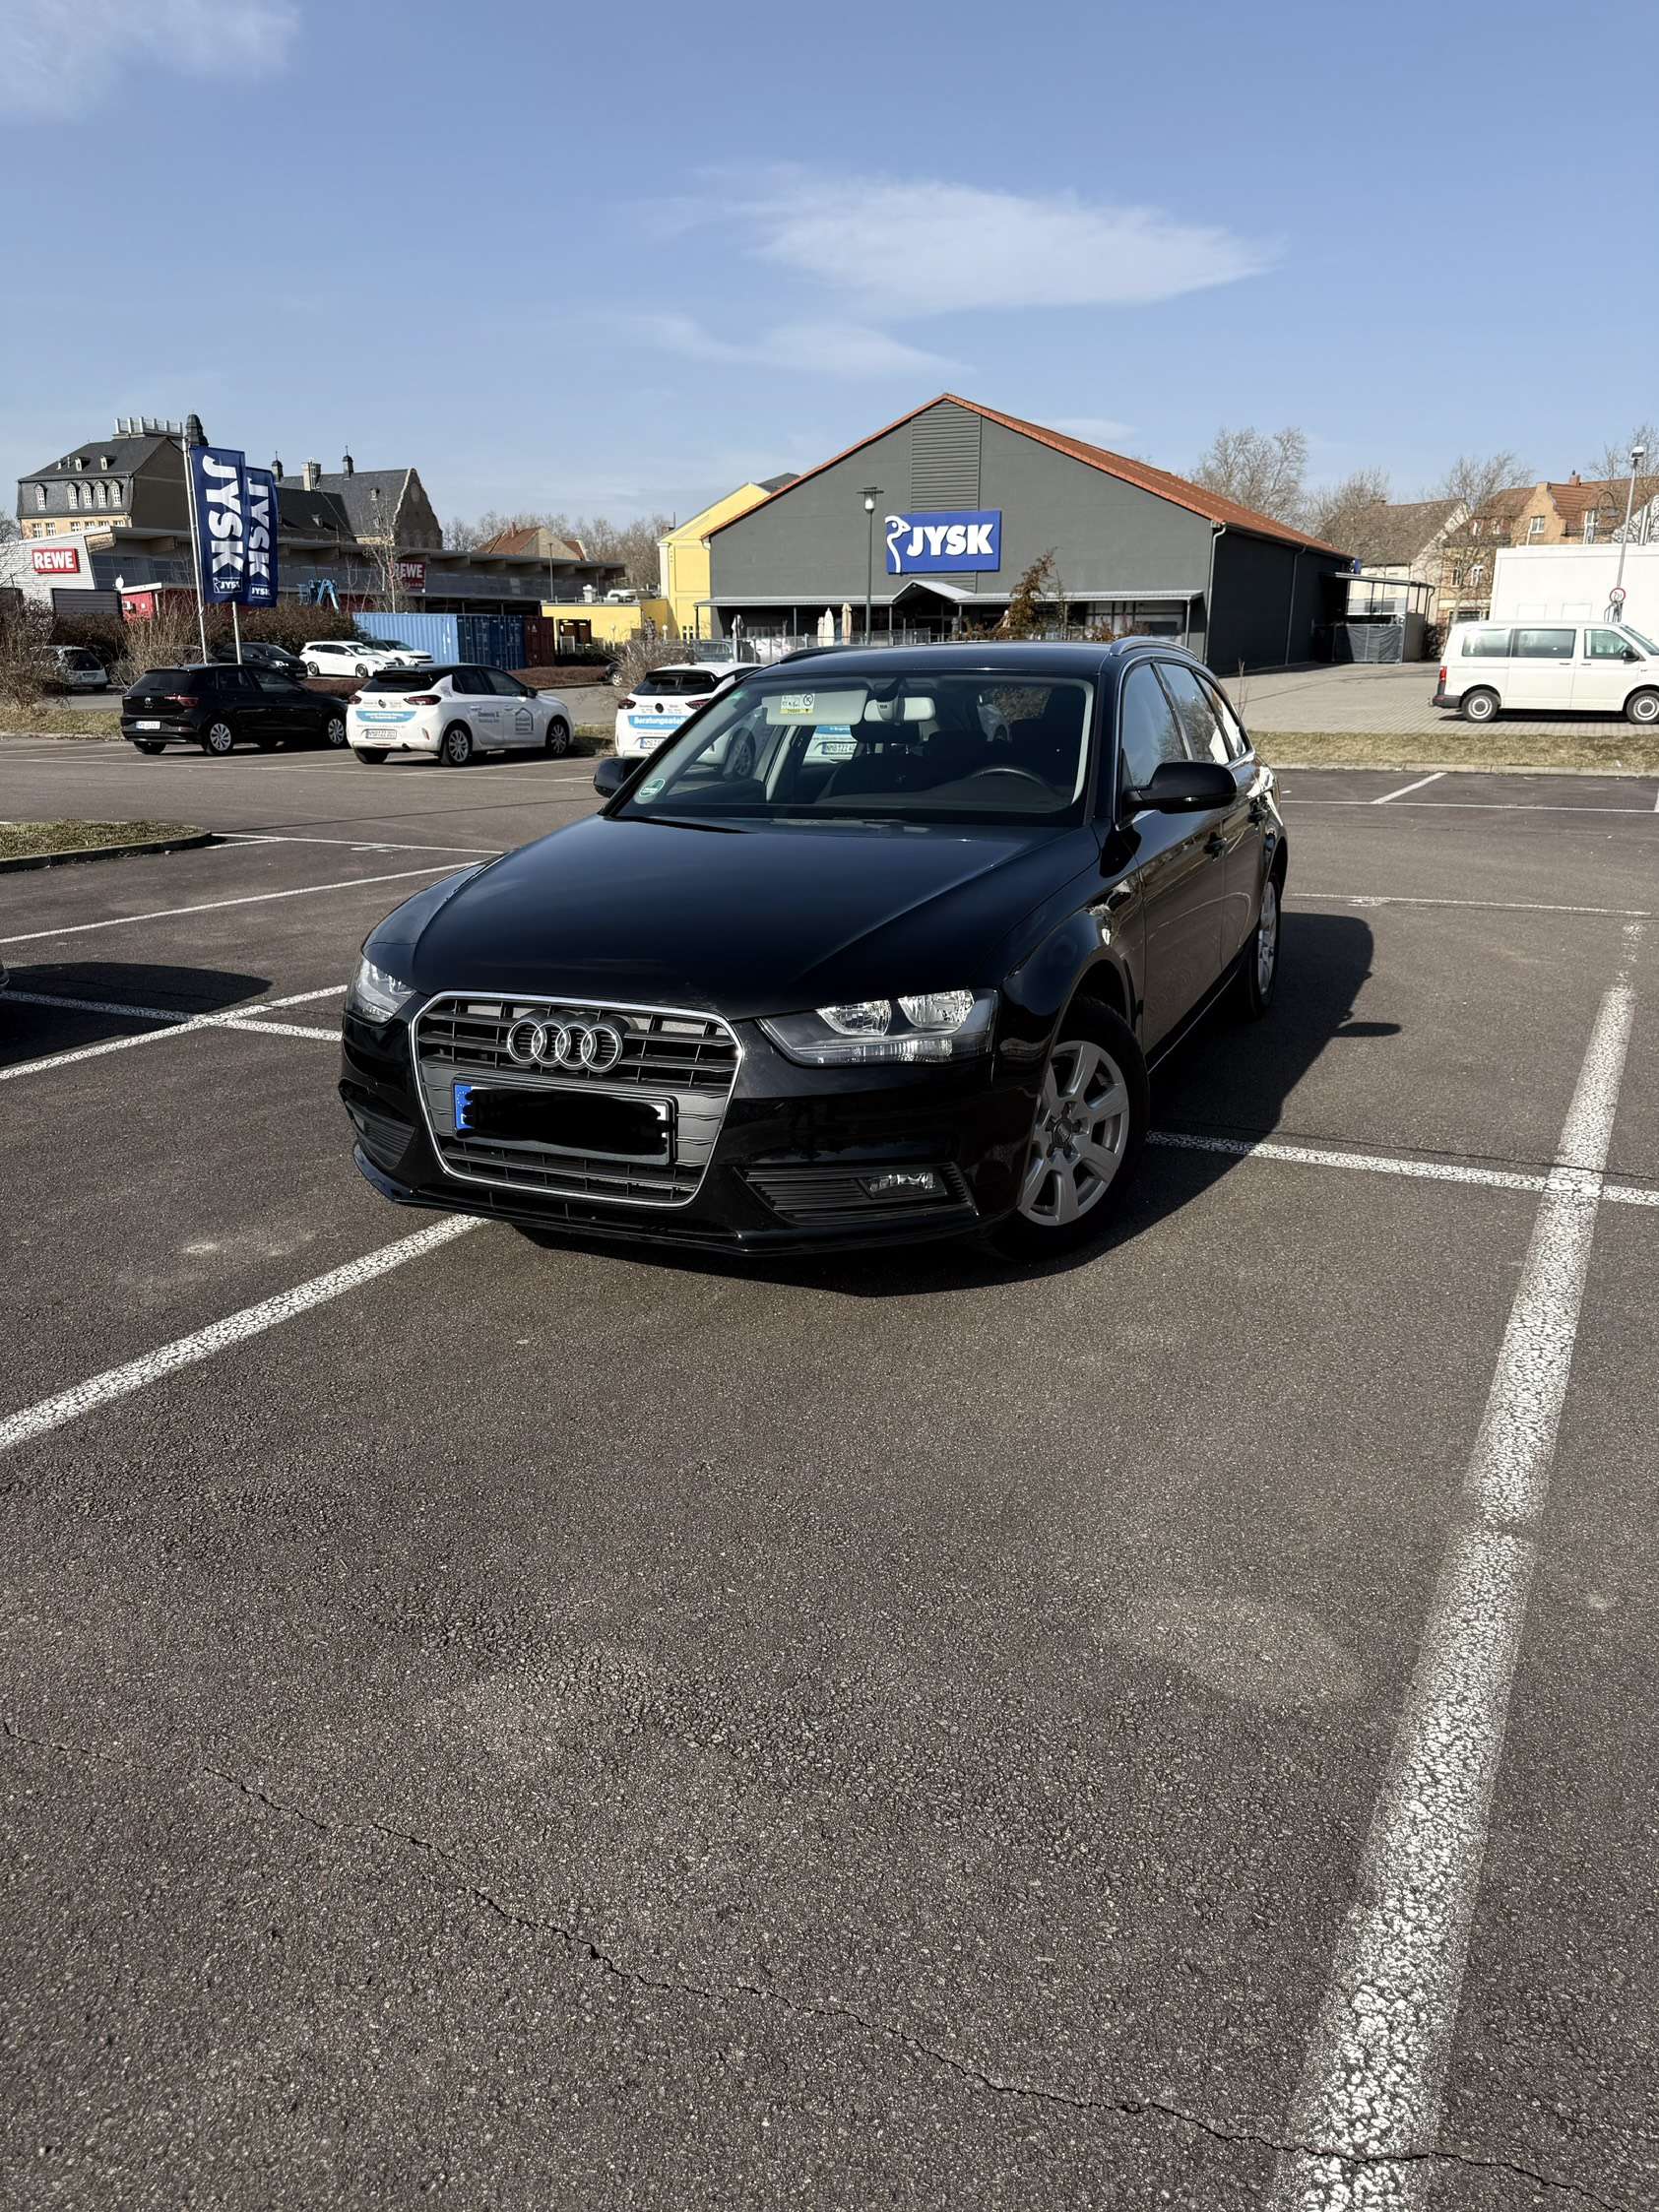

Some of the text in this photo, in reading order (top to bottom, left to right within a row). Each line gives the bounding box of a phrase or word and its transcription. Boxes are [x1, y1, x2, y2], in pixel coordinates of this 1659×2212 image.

[202, 455, 244, 573] JYSK
[906, 524, 993, 557] JYSK
[33, 551, 74, 569] REWE
